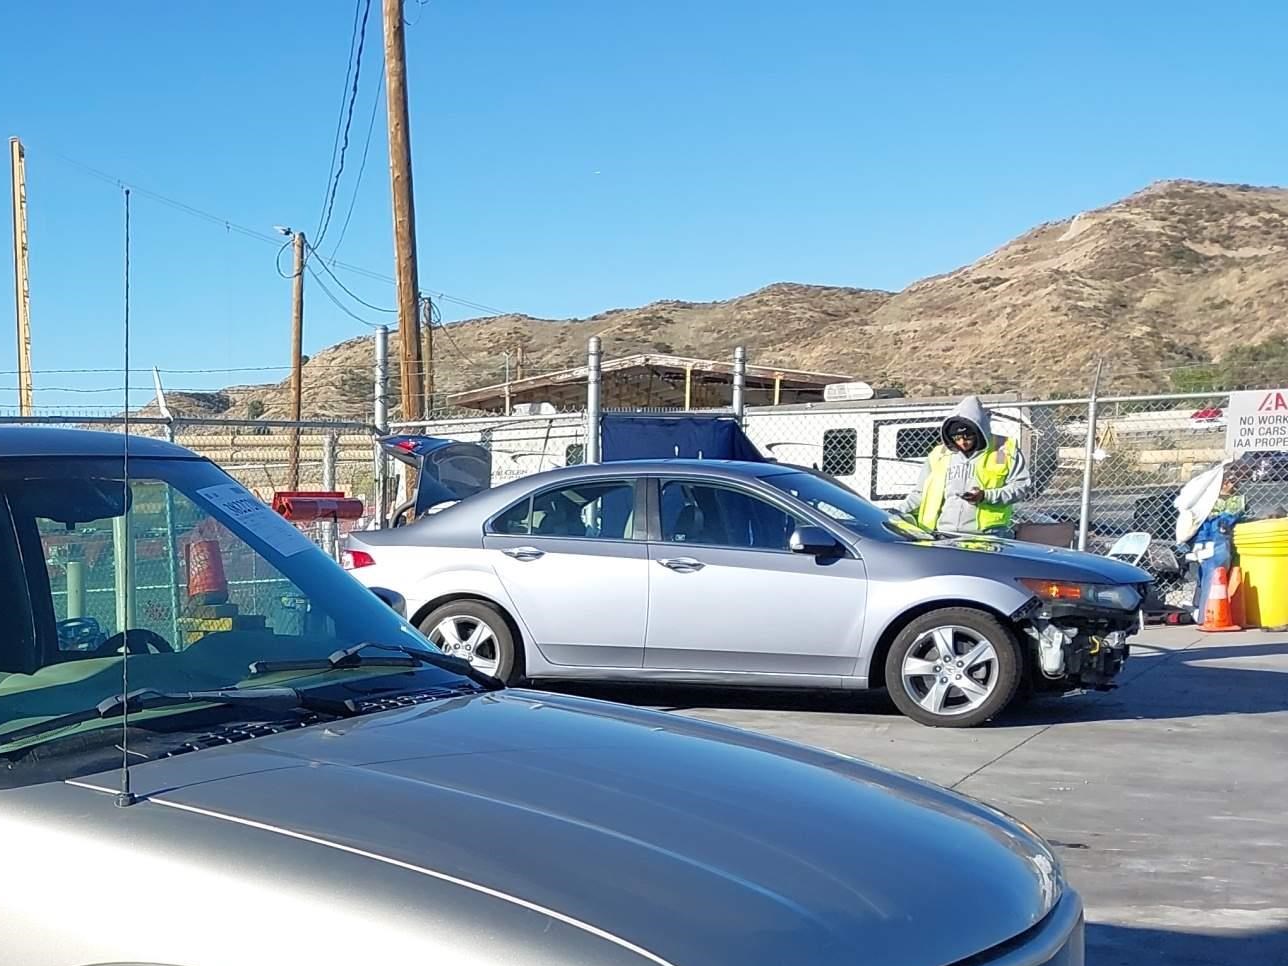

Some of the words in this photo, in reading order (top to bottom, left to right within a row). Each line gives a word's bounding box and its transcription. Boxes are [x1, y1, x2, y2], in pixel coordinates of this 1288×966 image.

[1240, 416, 1254, 425] NO
[1258, 415, 1288, 425] WORK
[1240, 427, 1255, 436] ON
[1258, 426, 1287, 436] CARS
[1233, 439, 1251, 448] IAA
